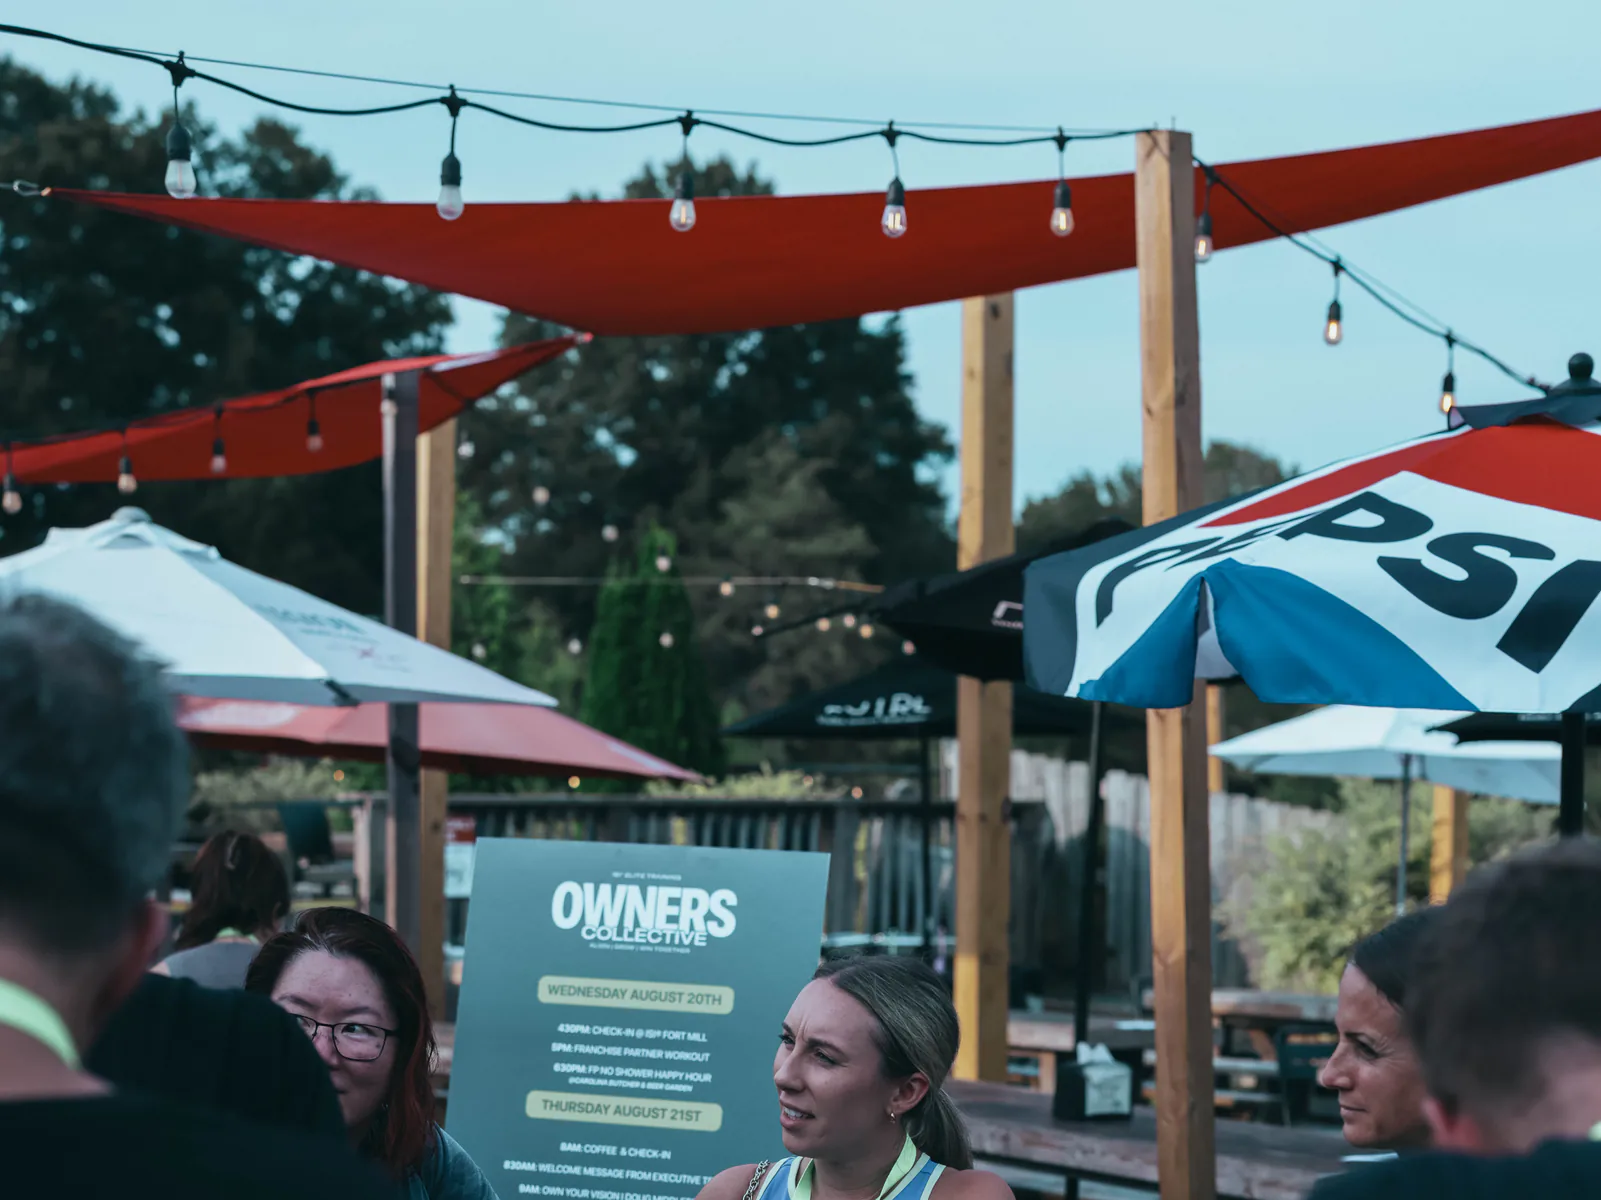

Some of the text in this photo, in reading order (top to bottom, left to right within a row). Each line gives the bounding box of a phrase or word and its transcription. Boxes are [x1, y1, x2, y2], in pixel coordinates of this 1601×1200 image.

[551, 880, 738, 938] OWNERS
[581, 925, 708, 947] COLLECTIVE
[547, 984, 722, 1006] WEDNESDAY AUGUST 20TH
[592, 1025, 635, 1038] CHECK-IN
[662, 1030, 687, 1041] FORT
[687, 1032, 708, 1042] MILL
[574, 1043, 623, 1056] FRANCHISE
[623, 1047, 664, 1059] PARTNER
[664, 1050, 710, 1062] WORKOUT
[588, 1064, 599, 1075] FP
[600, 1065, 614, 1076] NO
[614, 1066, 654, 1079] SHOWER
[654, 1069, 684, 1081] HAPPY
[685, 1071, 712, 1083] HOUR
[541, 1099, 702, 1122] THURSDAY AUGUST 21ST
[583, 1143, 618, 1156] COFFEE
[619, 1146, 627, 1157] &
[627, 1147, 672, 1160] CHECK-IN
[538, 1162, 582, 1175] WELCOME
[583, 1165, 624, 1178] MESSAGE
[625, 1168, 651, 1180] FROM
[652, 1171, 701, 1185] EXECUTIVE
[541, 1185, 565, 1196] OWN
[565, 1187, 589, 1198] YOUR
[590, 1188, 620, 1200] VISION
